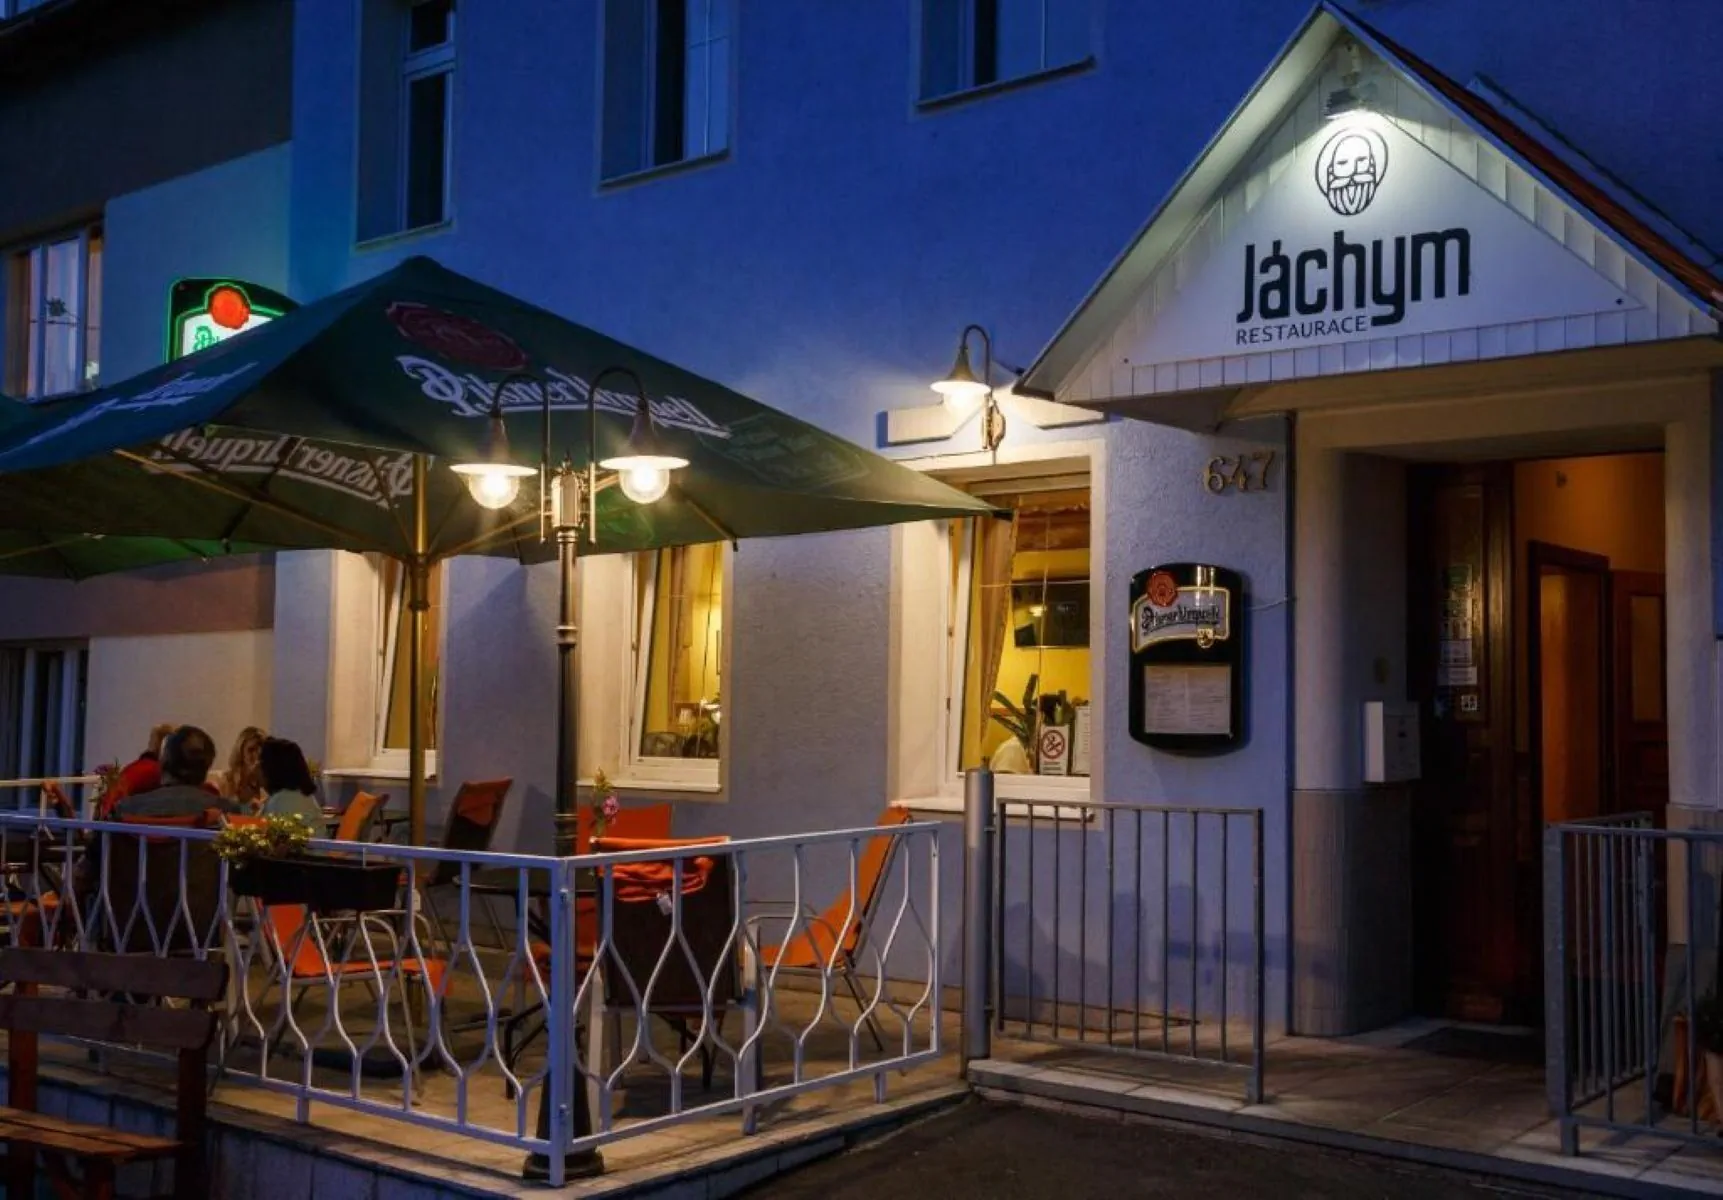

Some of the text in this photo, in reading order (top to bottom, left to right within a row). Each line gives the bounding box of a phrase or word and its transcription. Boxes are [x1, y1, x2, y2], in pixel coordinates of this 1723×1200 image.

[1236, 227, 1471, 326] Jáchym
[1236, 316, 1368, 345] RESTAURACE
[1206, 449, 1275, 491] 647
